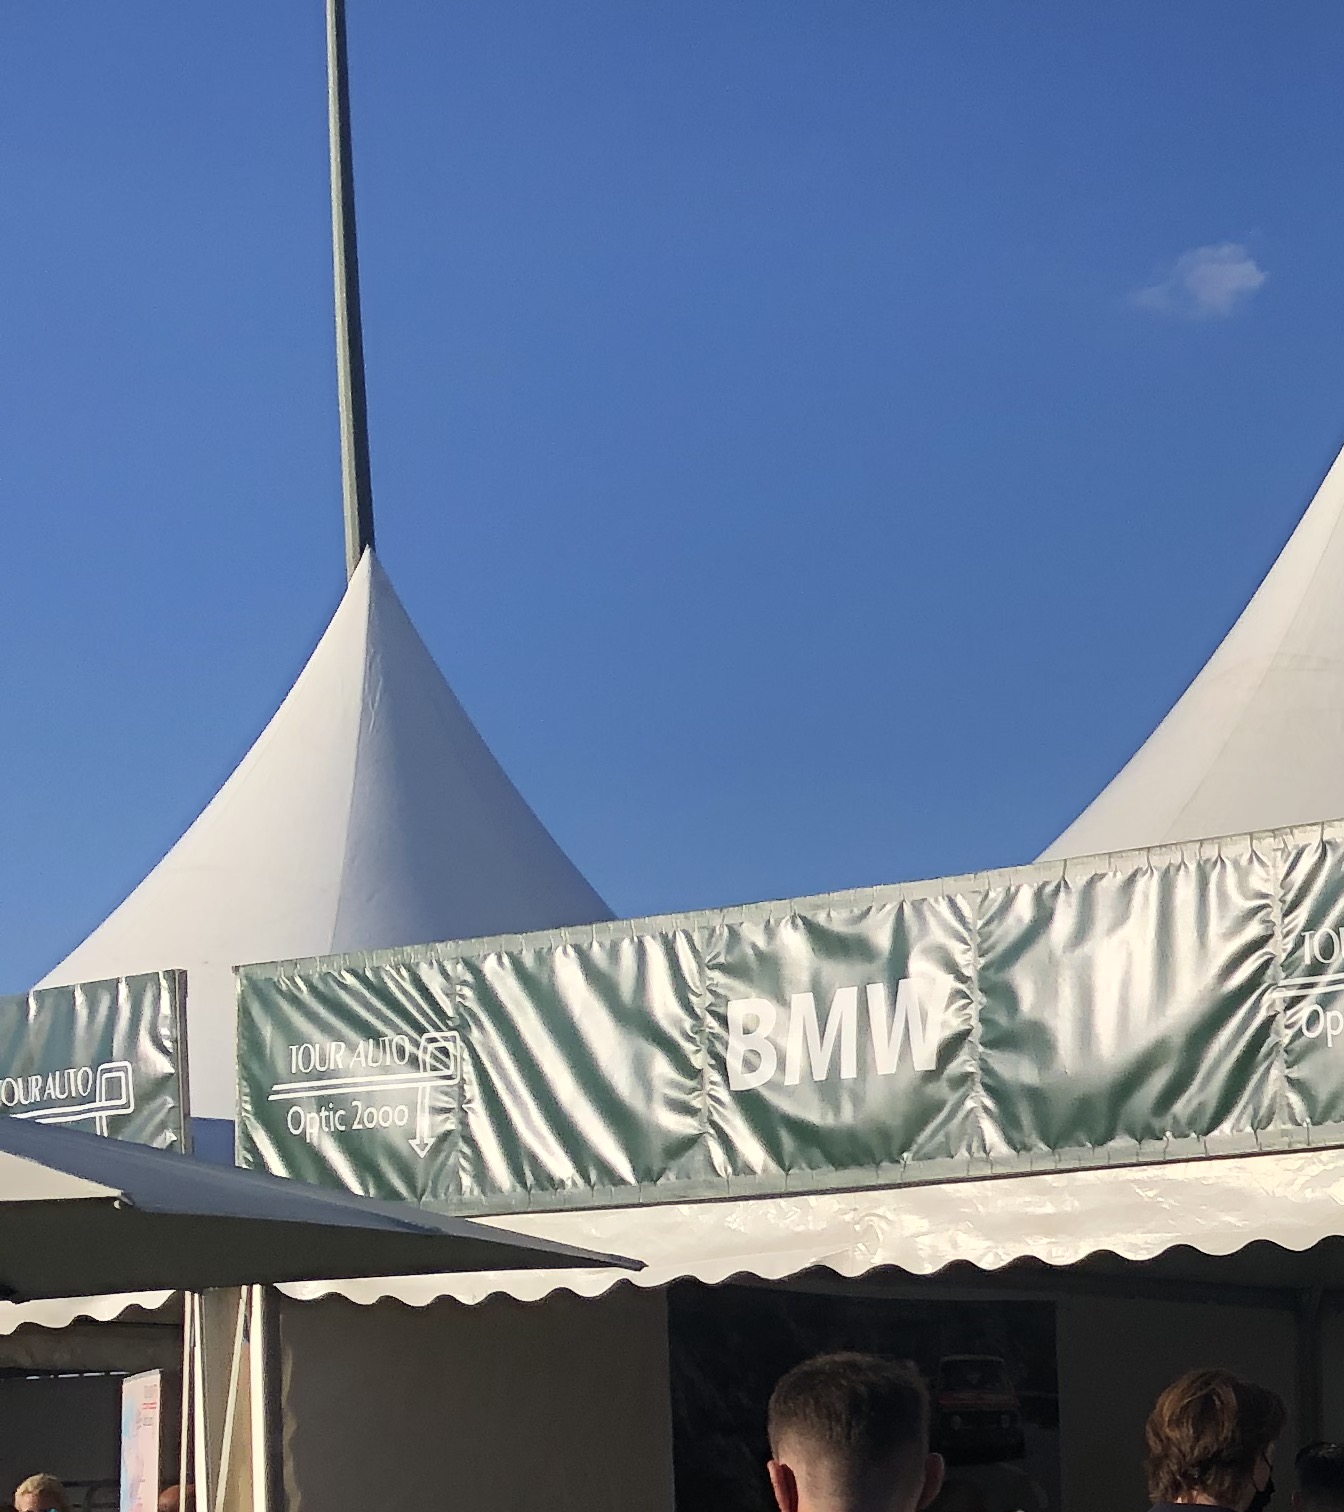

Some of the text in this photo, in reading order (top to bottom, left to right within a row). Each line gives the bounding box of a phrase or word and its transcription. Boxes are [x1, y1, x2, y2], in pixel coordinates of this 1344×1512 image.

[726, 974, 954, 1091] BMW
[289, 1034, 410, 1074] TOUR AUTO
[0, 1066, 93, 1107] OUR AUTO
[287, 1101, 409, 1144] Optic 2000
